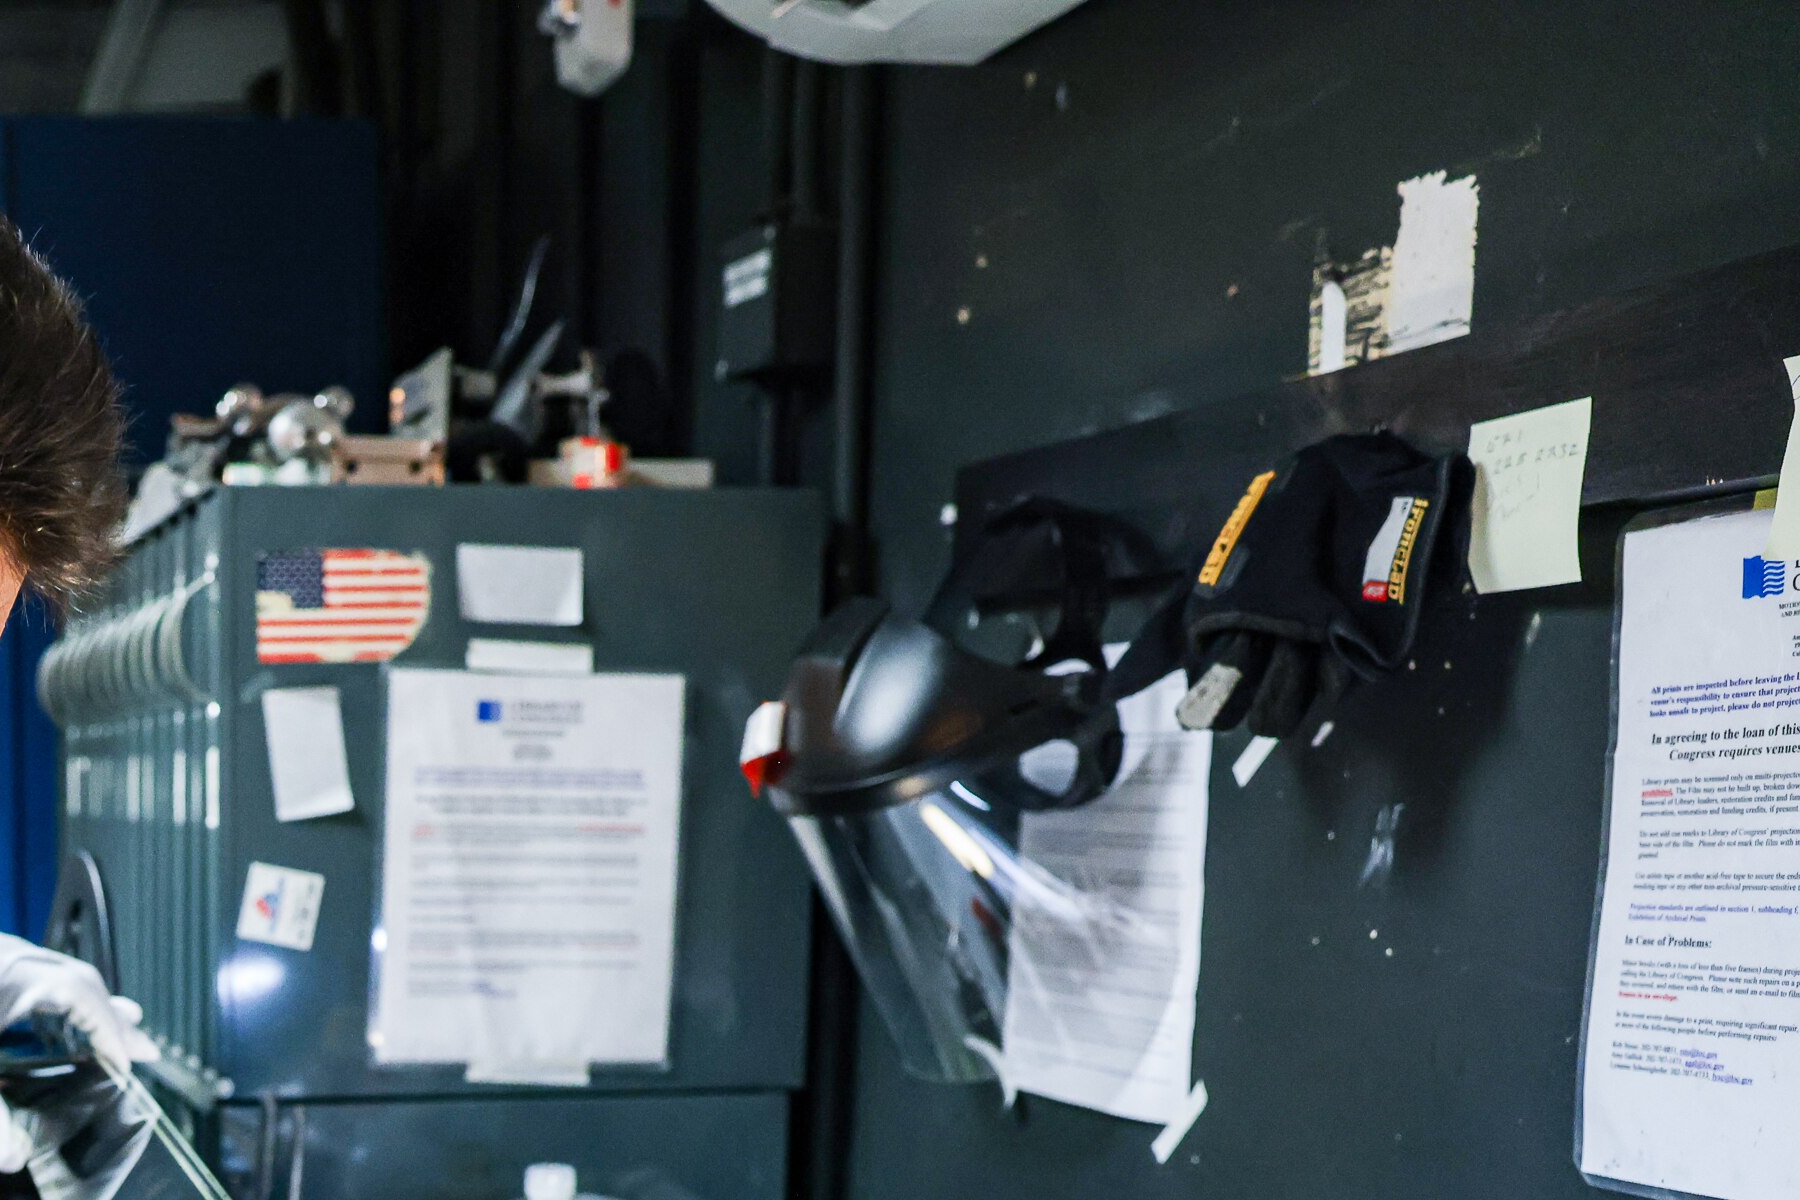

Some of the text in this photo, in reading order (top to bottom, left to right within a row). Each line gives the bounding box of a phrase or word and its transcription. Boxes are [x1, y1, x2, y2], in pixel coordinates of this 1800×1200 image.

[1696, 680, 1728, 691] inspected
[1730, 677, 1754, 687] before
[1756, 675, 1782, 685] leaving
[1784, 672, 1795, 682] the
[1677, 692, 1721, 705] responsibility
[1732, 690, 1756, 700] ensure
[1759, 688, 1773, 697] that
[1700, 704, 1726, 715] project,
[1728, 702, 1750, 713] please
[1751, 700, 1761, 709] do
[1763, 700, 1775, 708] not
[1652, 733, 1662, 745] In
[1664, 730, 1708, 746] agreeing
[1710, 730, 1721, 741] to
[1723, 728, 1740, 740] the
[1742, 727, 1765, 739] loan
[1768, 724, 1780, 737] of
[1669, 749, 1716, 762] Congress
[1719, 744, 1763, 760] requires
[1776, 793, 1788, 801] and
[1754, 838, 1764, 847] the
[1780, 838, 1794, 846] with
[1775, 872, 1785, 880] the
[1657, 936, 1666, 946] of
[1668, 934, 1712, 949] Problems:
[1724, 964, 1737, 972] five
[1763, 966, 1783, 976] during
[1759, 989, 1780, 997] e-mail
[1745, 1021, 1778, 1031] significant
[1778, 1024, 1799, 1034] repair,
[1718, 1030, 1752, 1041] performing
